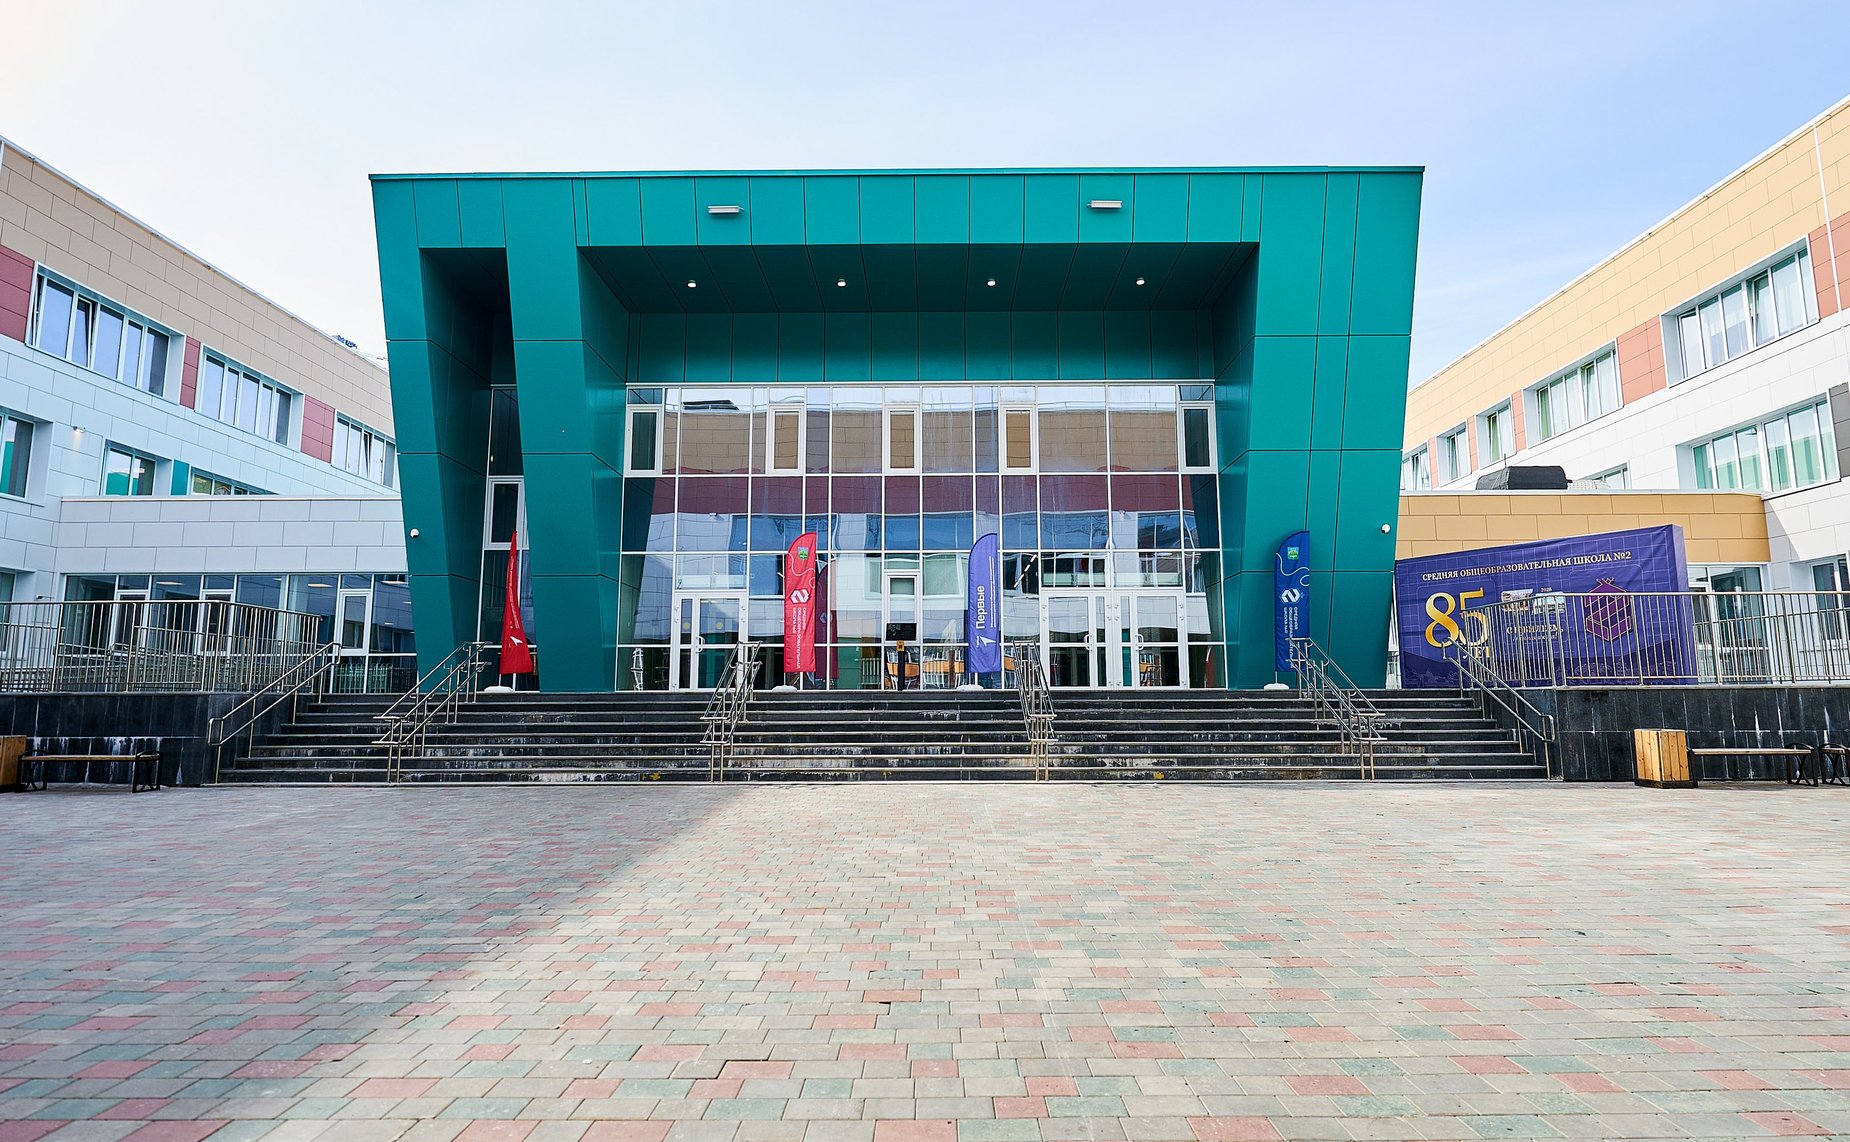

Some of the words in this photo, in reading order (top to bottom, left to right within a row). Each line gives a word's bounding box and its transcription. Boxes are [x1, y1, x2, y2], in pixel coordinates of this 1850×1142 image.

[1422, 571, 1459, 581] СРЕДНЯЯ
[1460, 558, 1572, 577] ОБЩЕОБРАЗОВАТЕЛЬНАЯ
[1573, 553, 1612, 566] ШКОЛА
[1613, 551, 1632, 561] №2
[976, 586, 987, 629] Первые
[1425, 587, 1489, 648] 85
